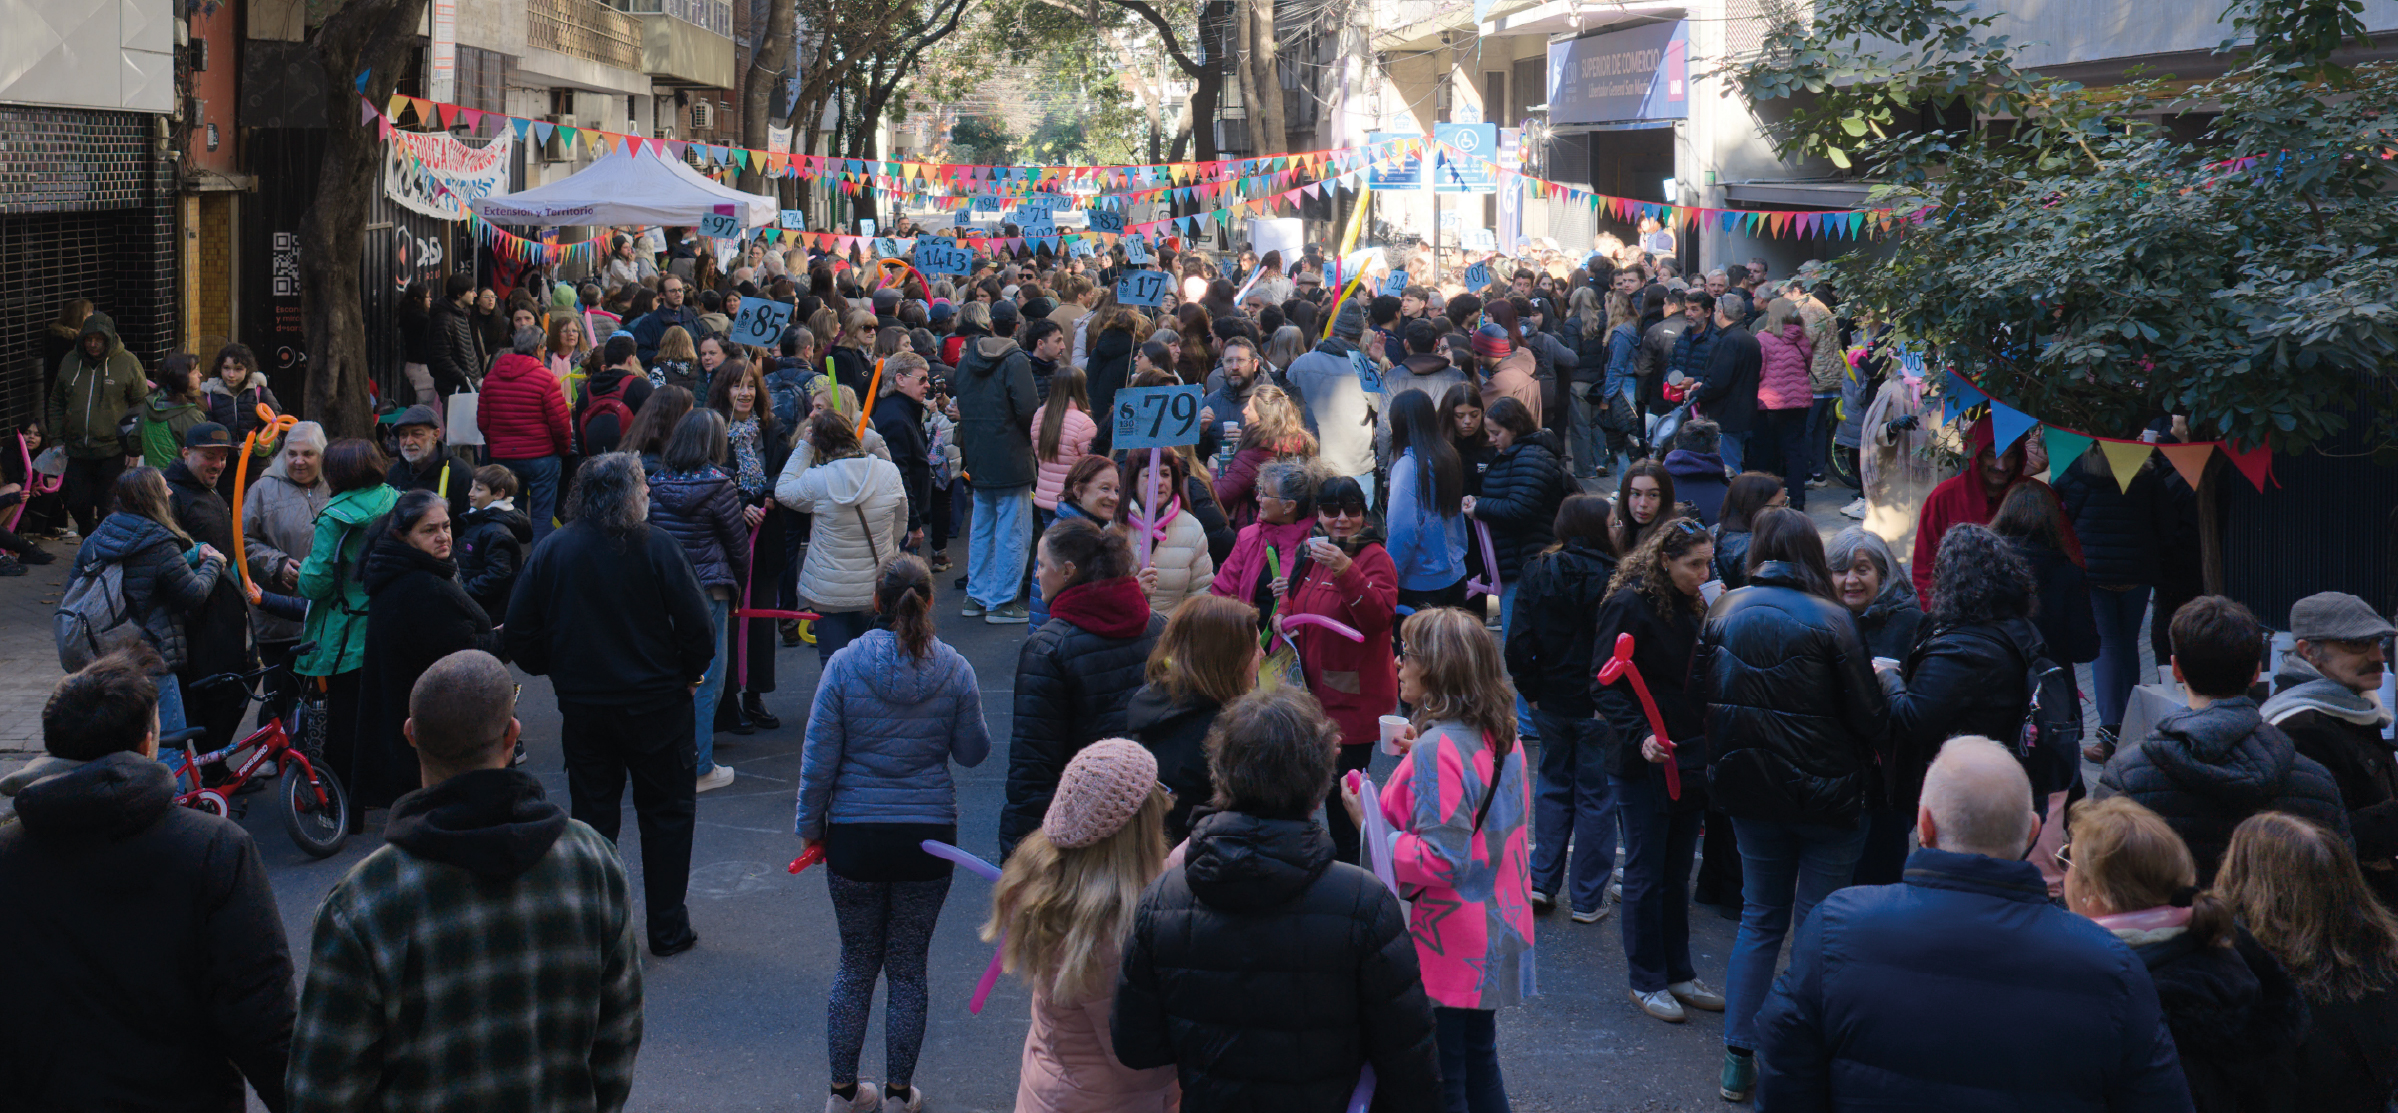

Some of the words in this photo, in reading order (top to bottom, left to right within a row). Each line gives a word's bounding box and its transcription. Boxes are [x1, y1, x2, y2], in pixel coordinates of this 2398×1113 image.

[1581, 55, 1610, 78] SUPERIOR
[1611, 53, 1621, 75] DE
[1621, 48, 1660, 74] COMERCIO
[1588, 82, 1609, 98] Libertador
[1609, 80, 1625, 96] General
[1625, 79, 1634, 95] San
[1670, 79, 1682, 95] UNR
[984, 197, 999, 211] 94
[1057, 197, 1071, 209] 70
[484, 206, 533, 217] Extensión
[536, 209, 542, 218] y
[544, 206, 594, 217] Territorio
[789, 212, 801, 225] 74
[959, 210, 969, 223] 18
[1030, 207, 1050, 223] 71
[1440, 212, 1456, 227] 95
[713, 216, 737, 236] 97
[1100, 213, 1122, 231] 82
[1474, 233, 1490, 245] 11
[1130, 238, 1144, 260] 15
[1470, 264, 1486, 283] 07
[1135, 275, 1163, 302] 17
[1391, 274, 1405, 291] 24
[751, 304, 786, 344] 85
[1143, 392, 1197, 438] 79
[1119, 420, 1134, 428] 130
[239, 744, 269, 777] FIREBIRD
